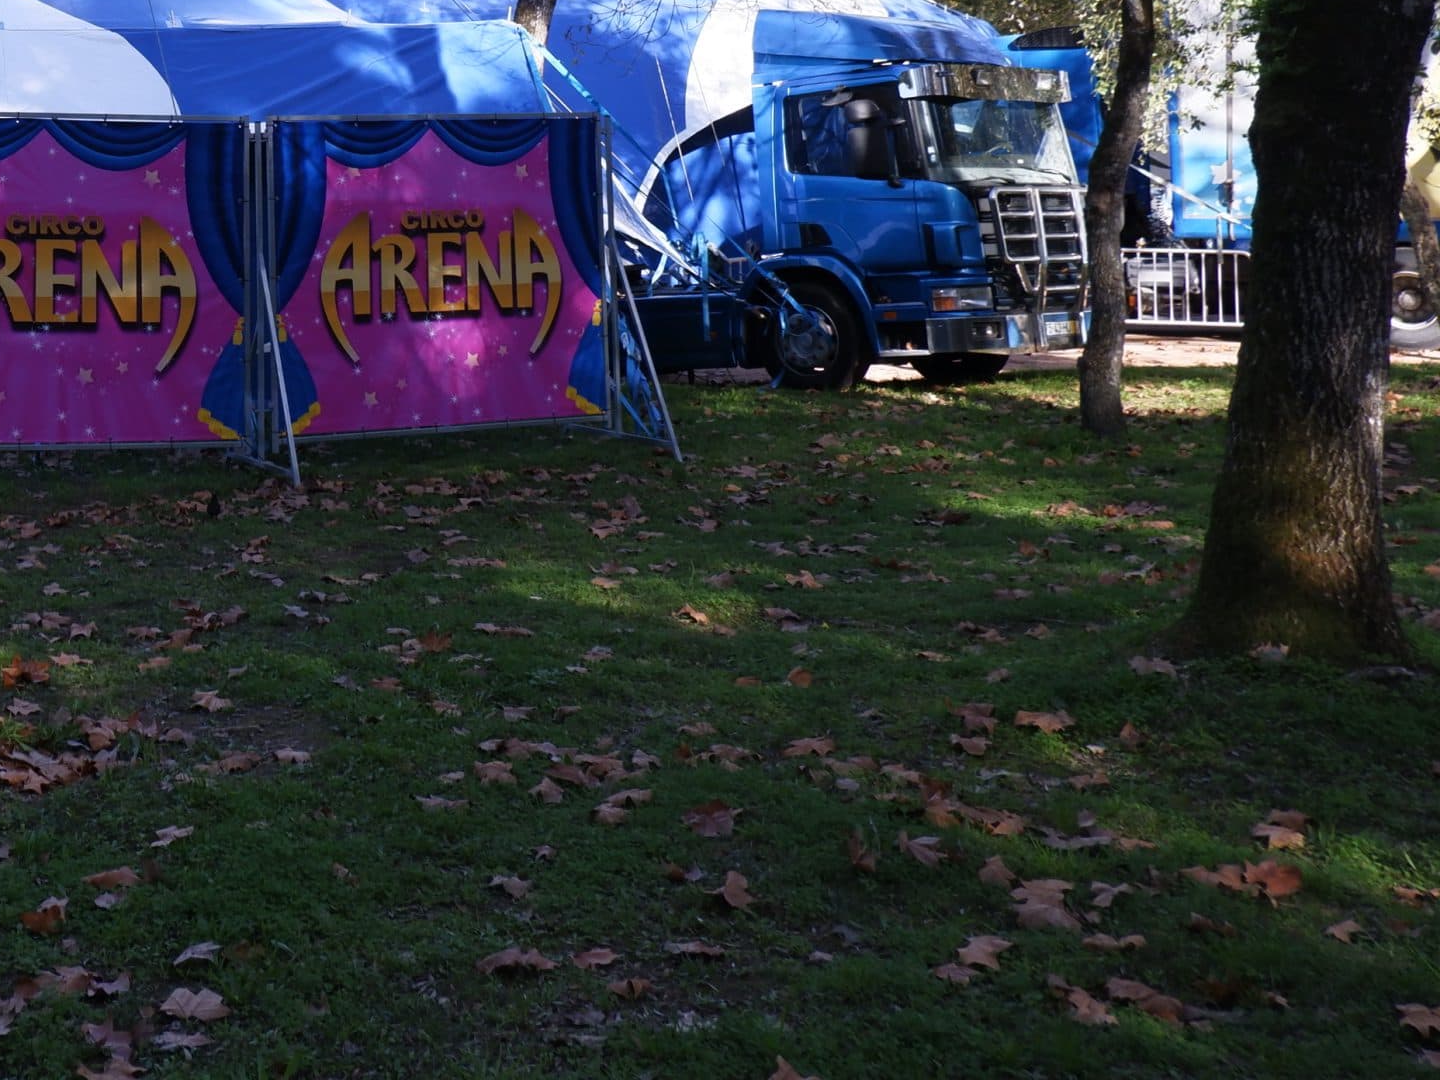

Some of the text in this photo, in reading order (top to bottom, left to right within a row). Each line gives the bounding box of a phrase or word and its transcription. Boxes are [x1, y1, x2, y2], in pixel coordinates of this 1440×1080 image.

[6, 215, 104, 235] CIRCO
[401, 209, 484, 228] CIRCO
[321, 208, 562, 362] ARENA
